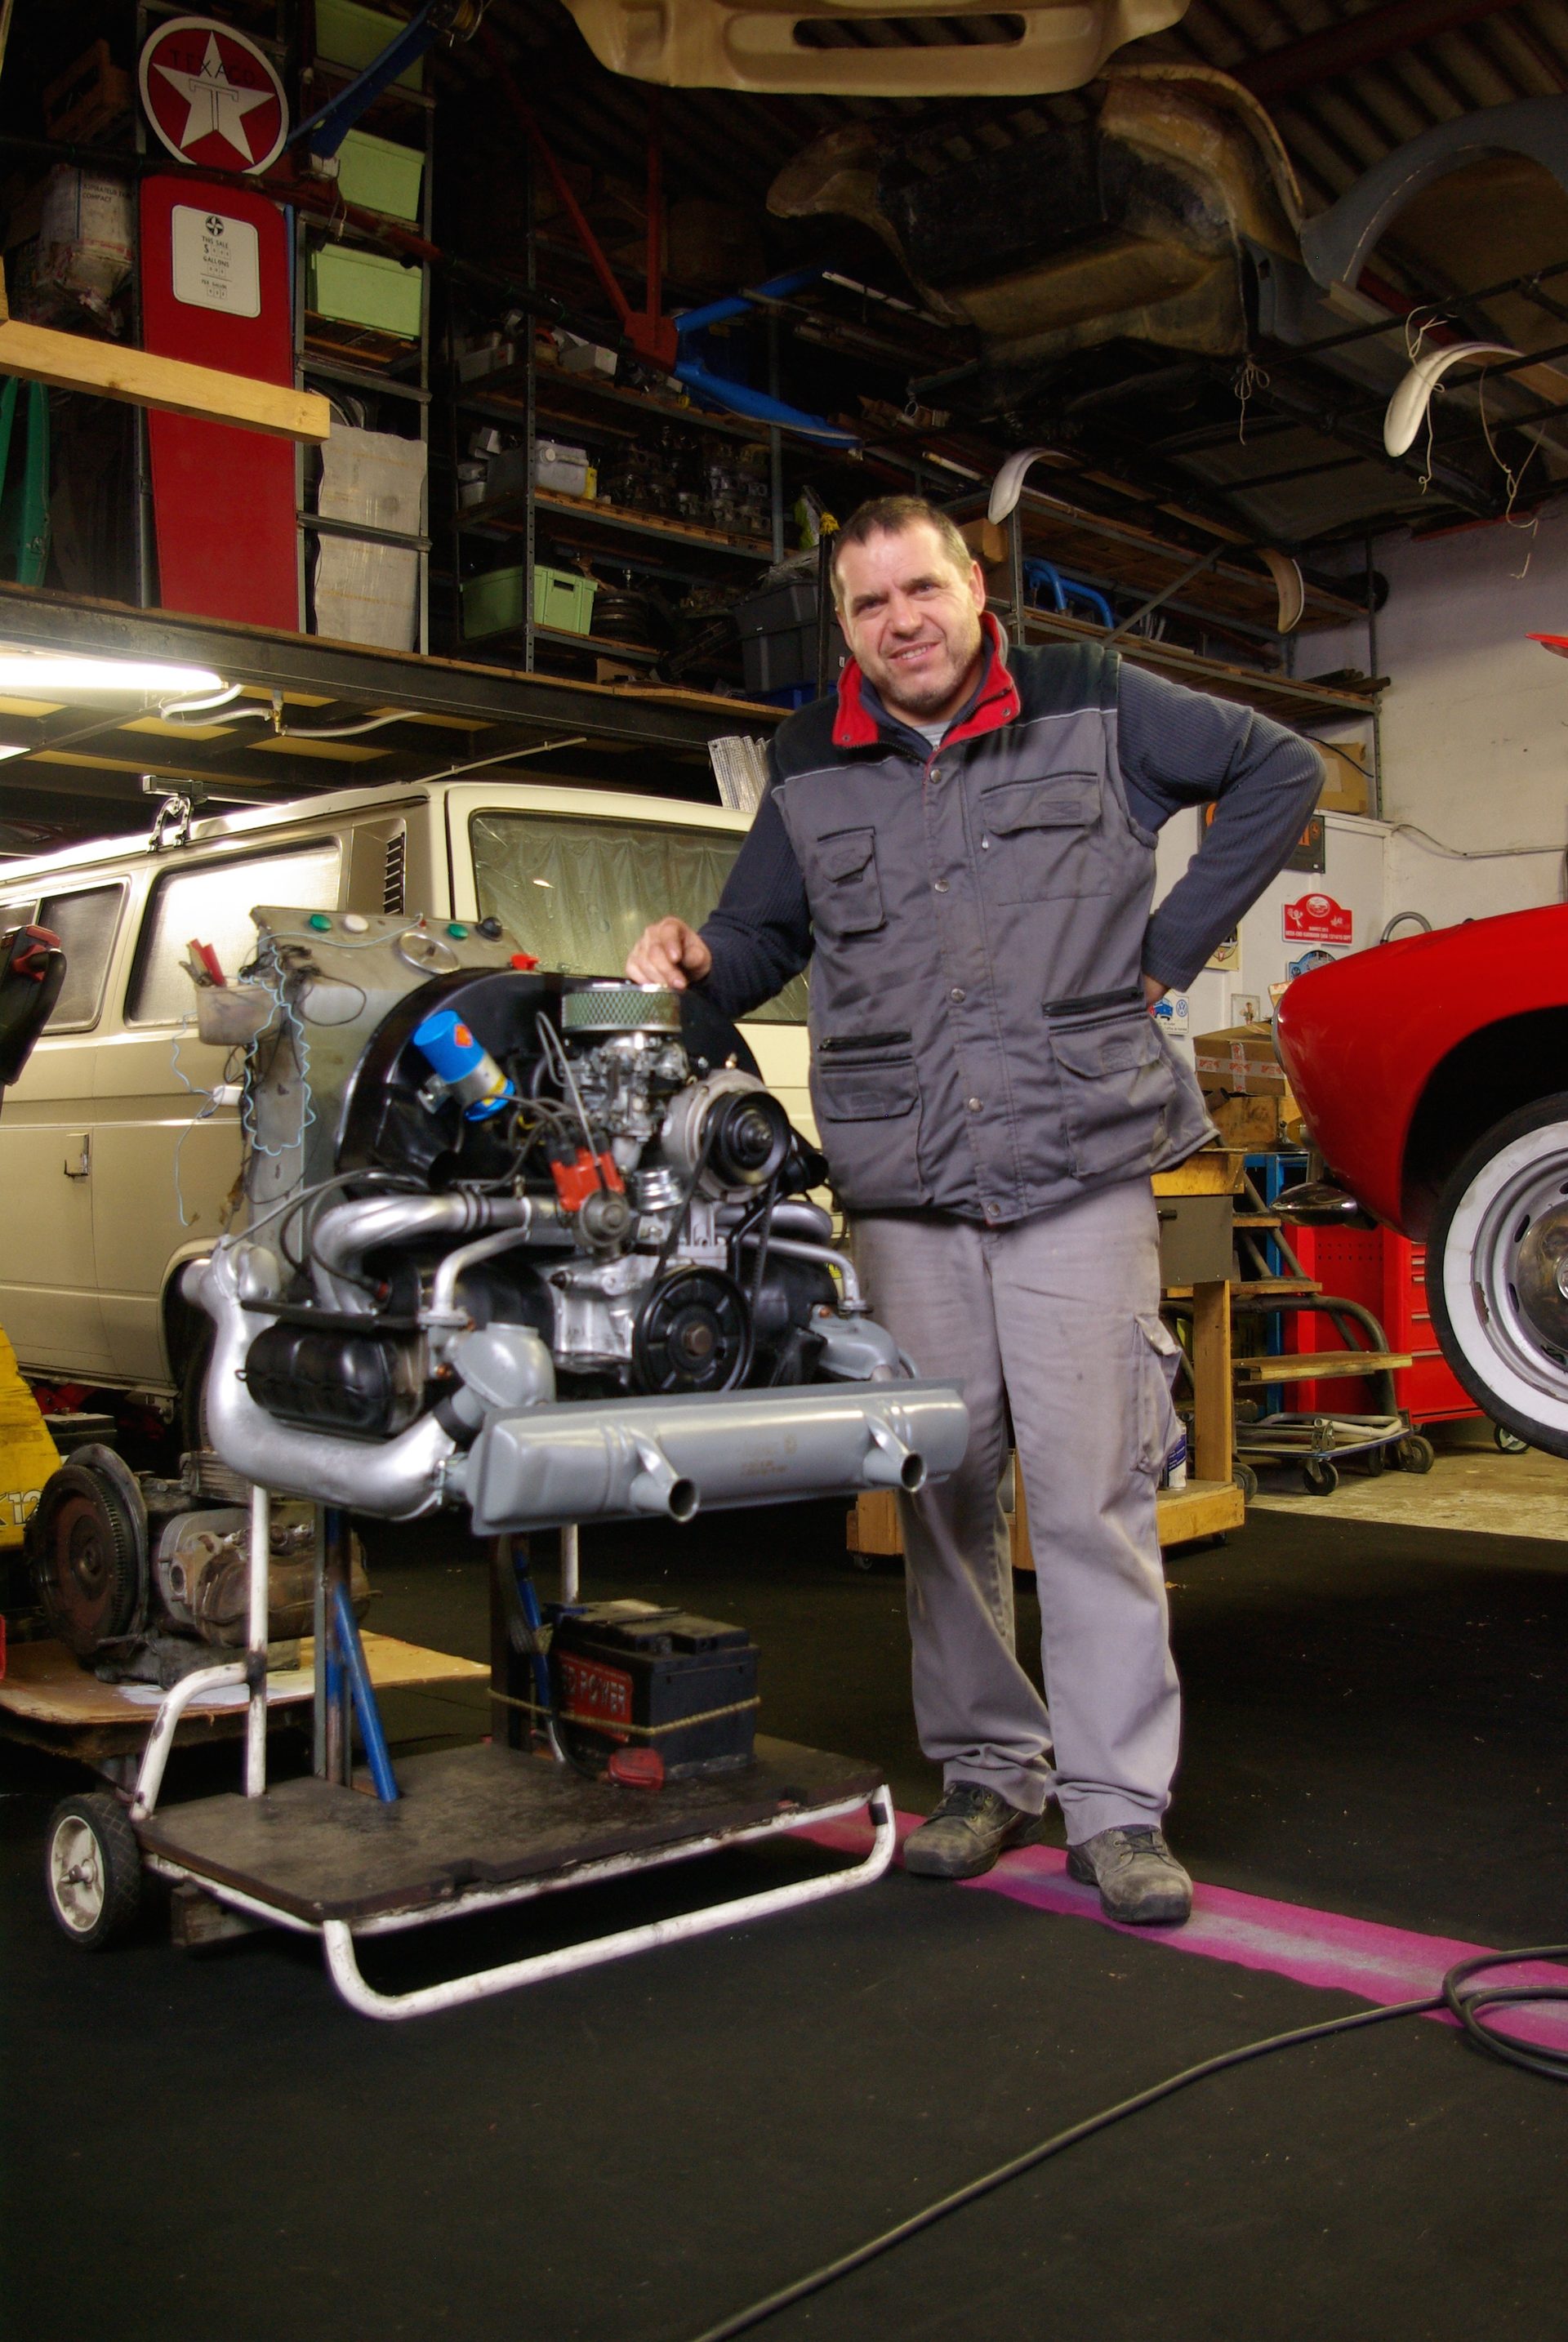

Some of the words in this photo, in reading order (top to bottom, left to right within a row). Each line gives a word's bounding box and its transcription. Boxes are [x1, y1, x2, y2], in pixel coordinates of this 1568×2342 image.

[170, 49, 255, 85] TEXACO
[82, 192, 112, 203] COMPACT
[202, 235, 213, 244] THIS
[216, 240, 229, 249] SALE
[203, 256, 229, 268] GALLONS
[581, 1670, 626, 1716] POWER
